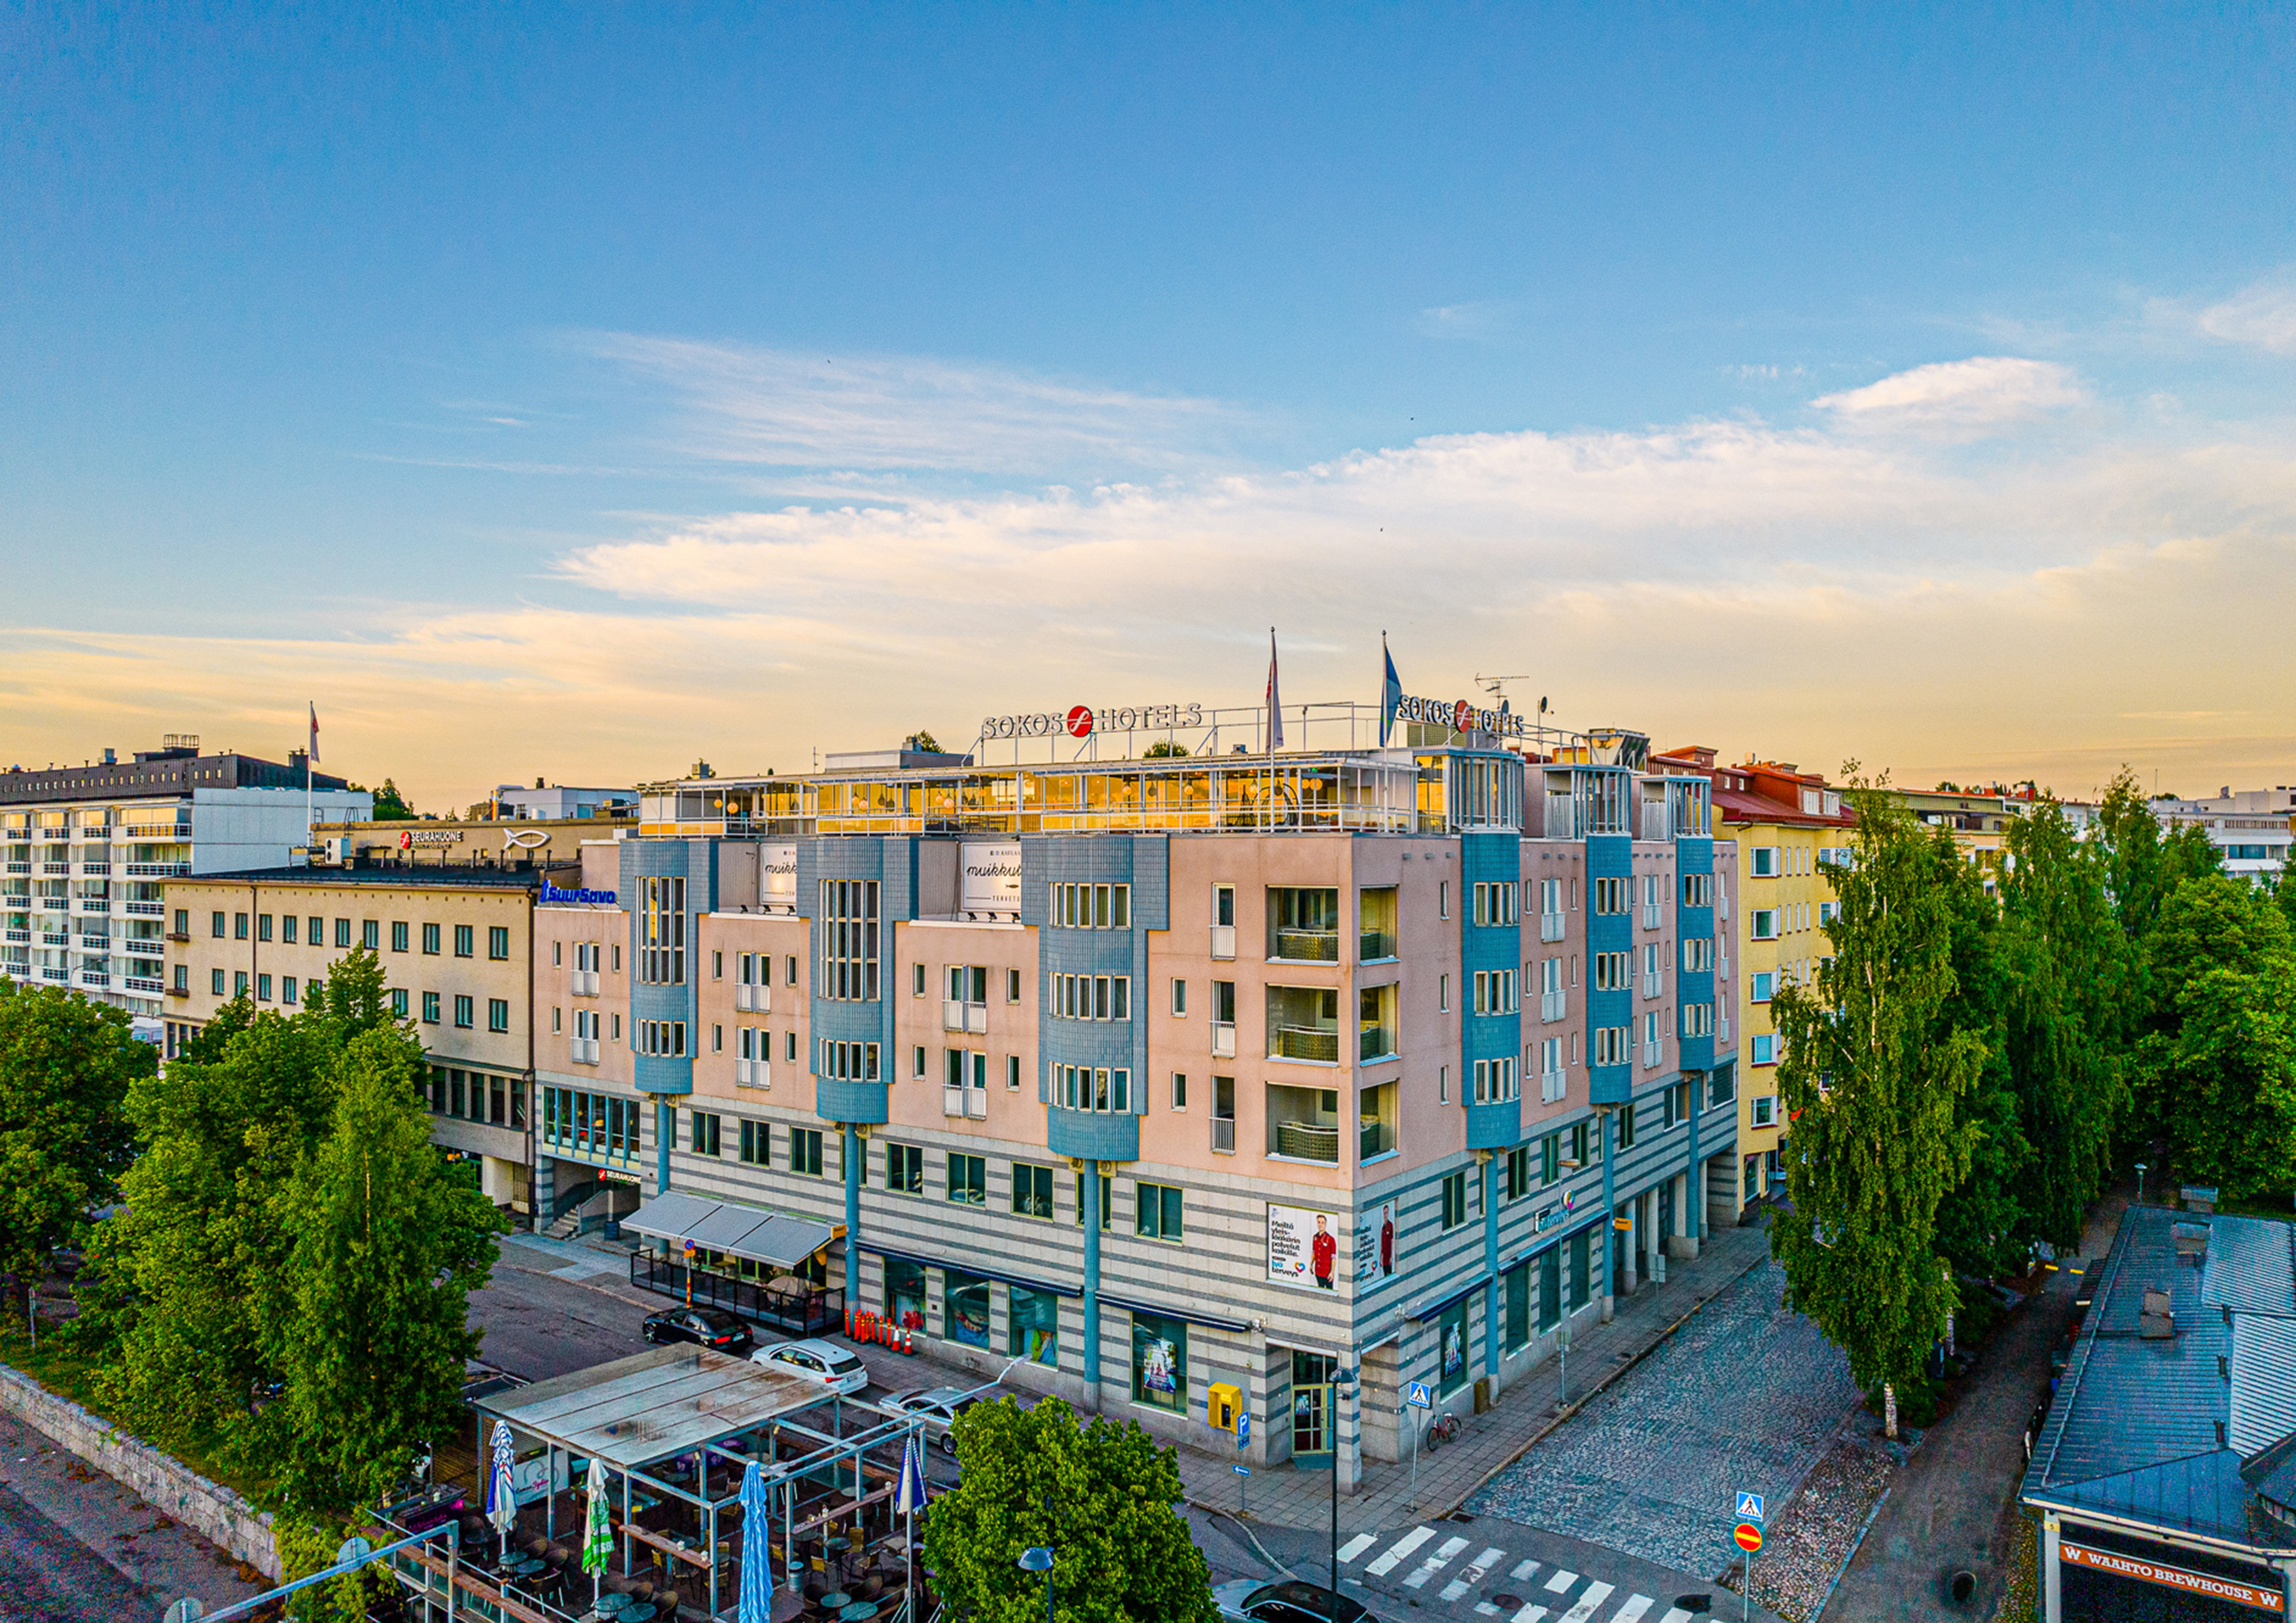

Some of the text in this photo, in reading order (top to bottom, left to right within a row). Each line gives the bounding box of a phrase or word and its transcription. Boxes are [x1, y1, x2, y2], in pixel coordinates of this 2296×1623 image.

[983, 703, 1202, 739] SOKOS HOTELS
[1399, 694, 1524, 736] SOKOS HOTELS
[411, 831, 463, 842] SEURAHUONE
[548, 887, 617, 904] SuurSavo
[1272, 1266, 1299, 1277] terveys
[1240, 1414, 1248, 1435] P
[2087, 1553, 2153, 1577] WAAHTO
[2155, 1567, 2253, 1601] BREWHOUSE
